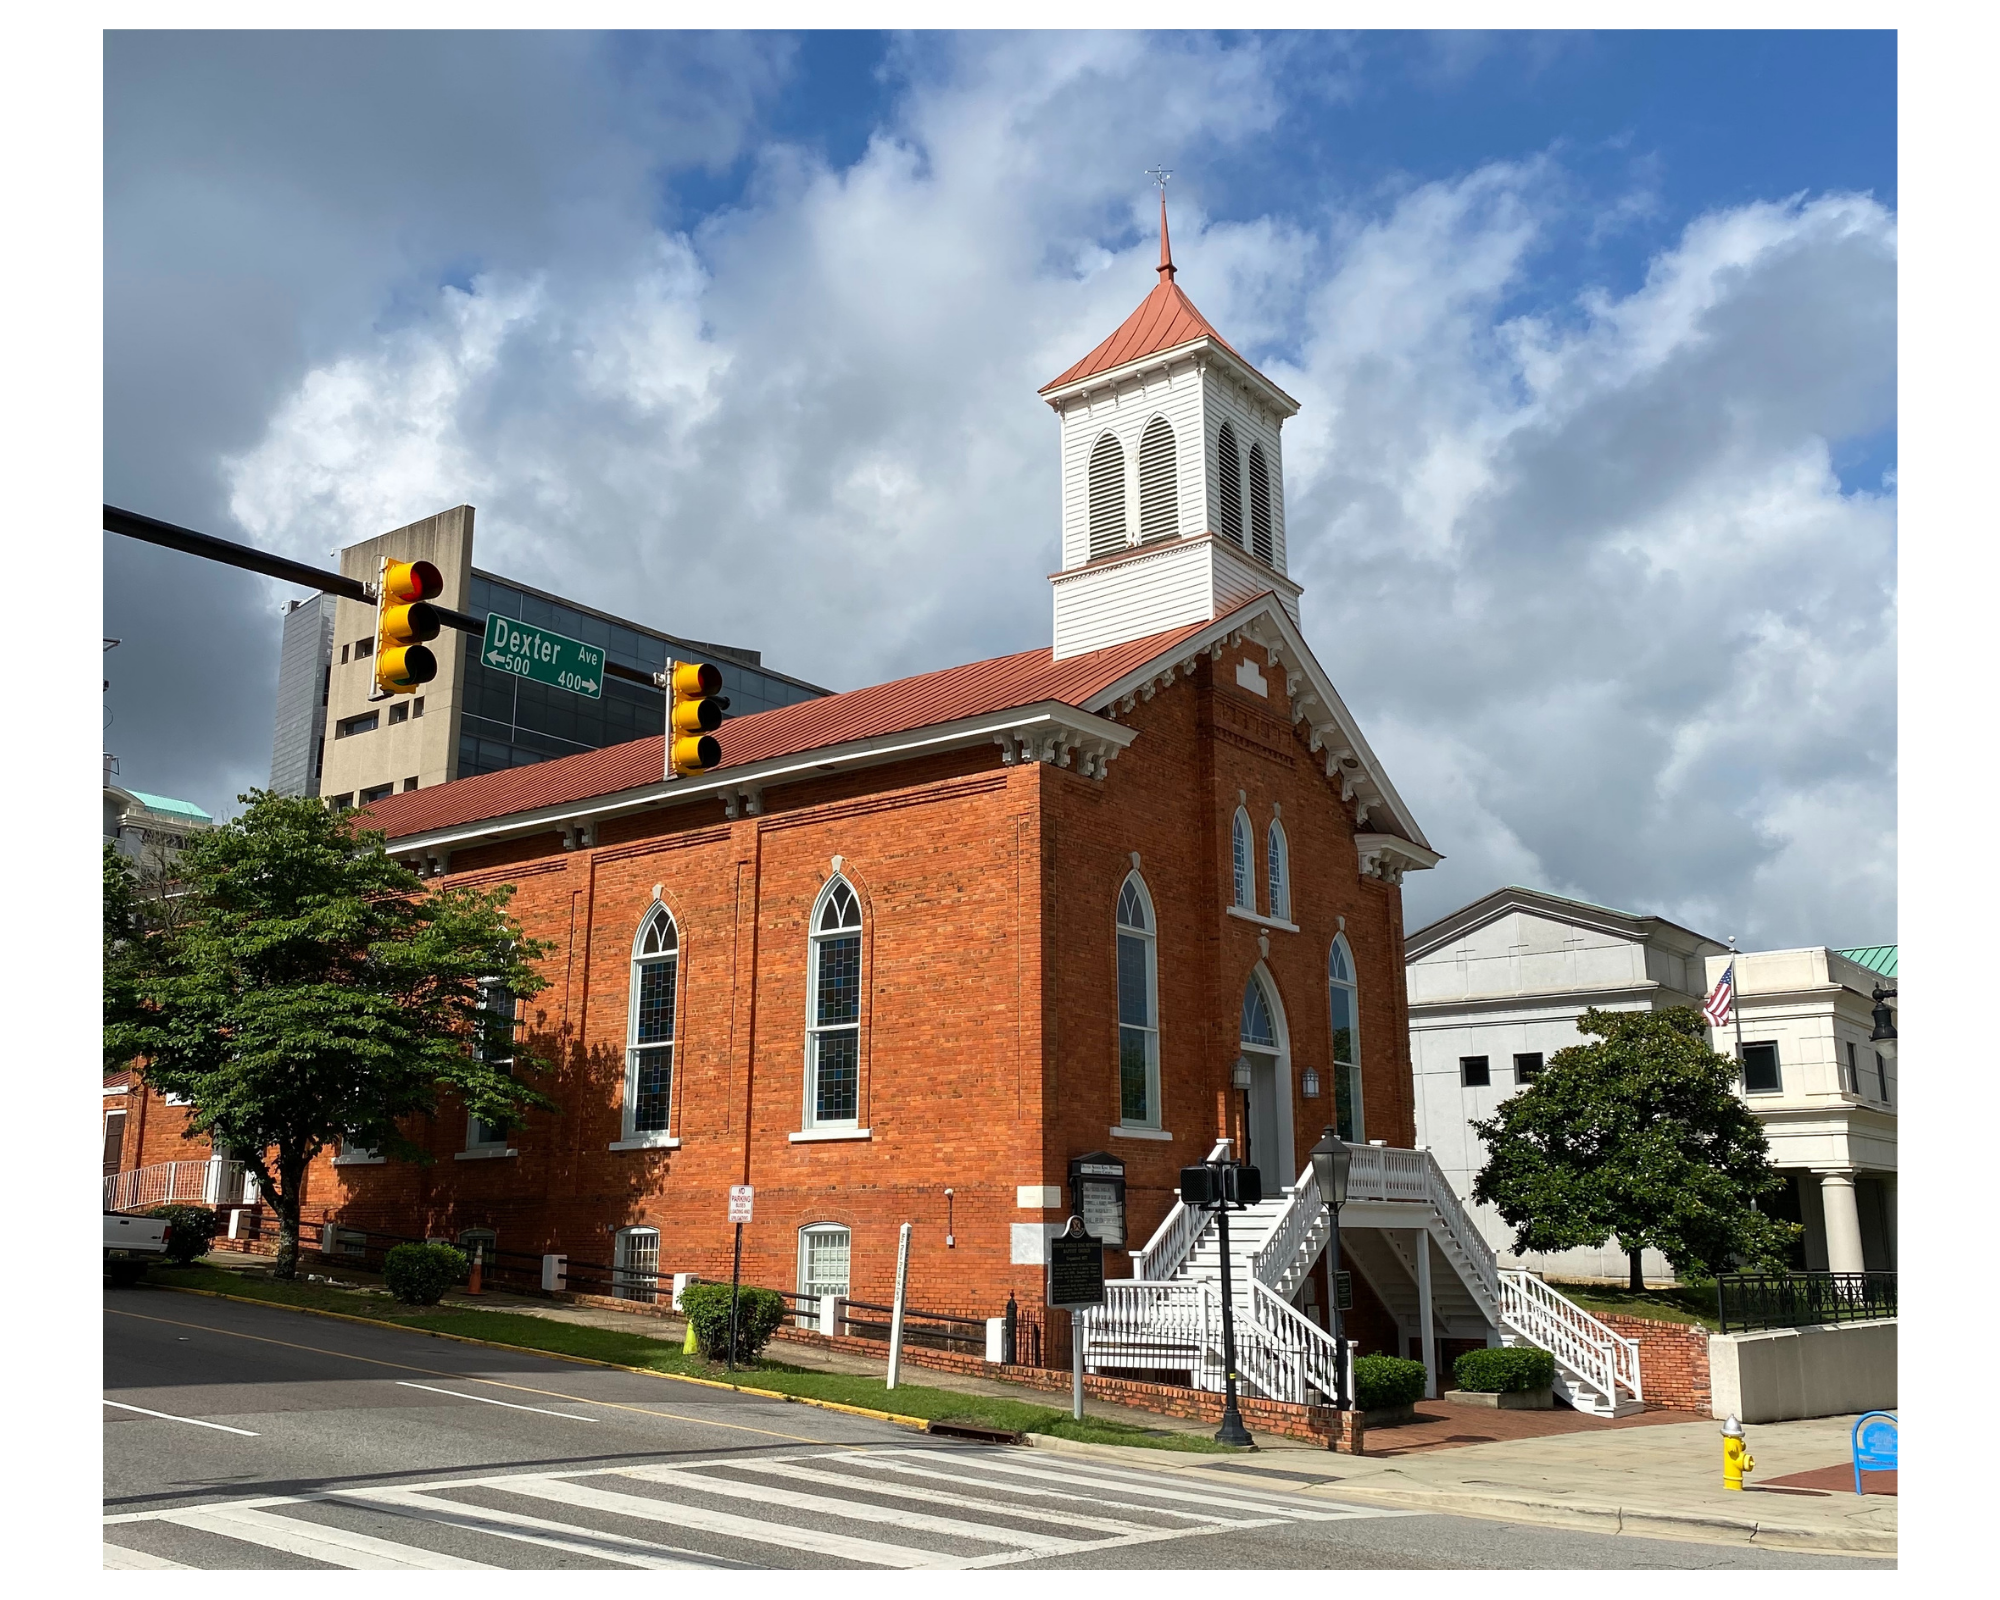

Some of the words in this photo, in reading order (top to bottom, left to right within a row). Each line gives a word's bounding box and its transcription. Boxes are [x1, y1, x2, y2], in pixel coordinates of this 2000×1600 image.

[494, 619, 561, 665] Dexter
[578, 646, 598, 665] Ave
[505, 654, 530, 675] 500
[558, 671, 581, 690] 400
